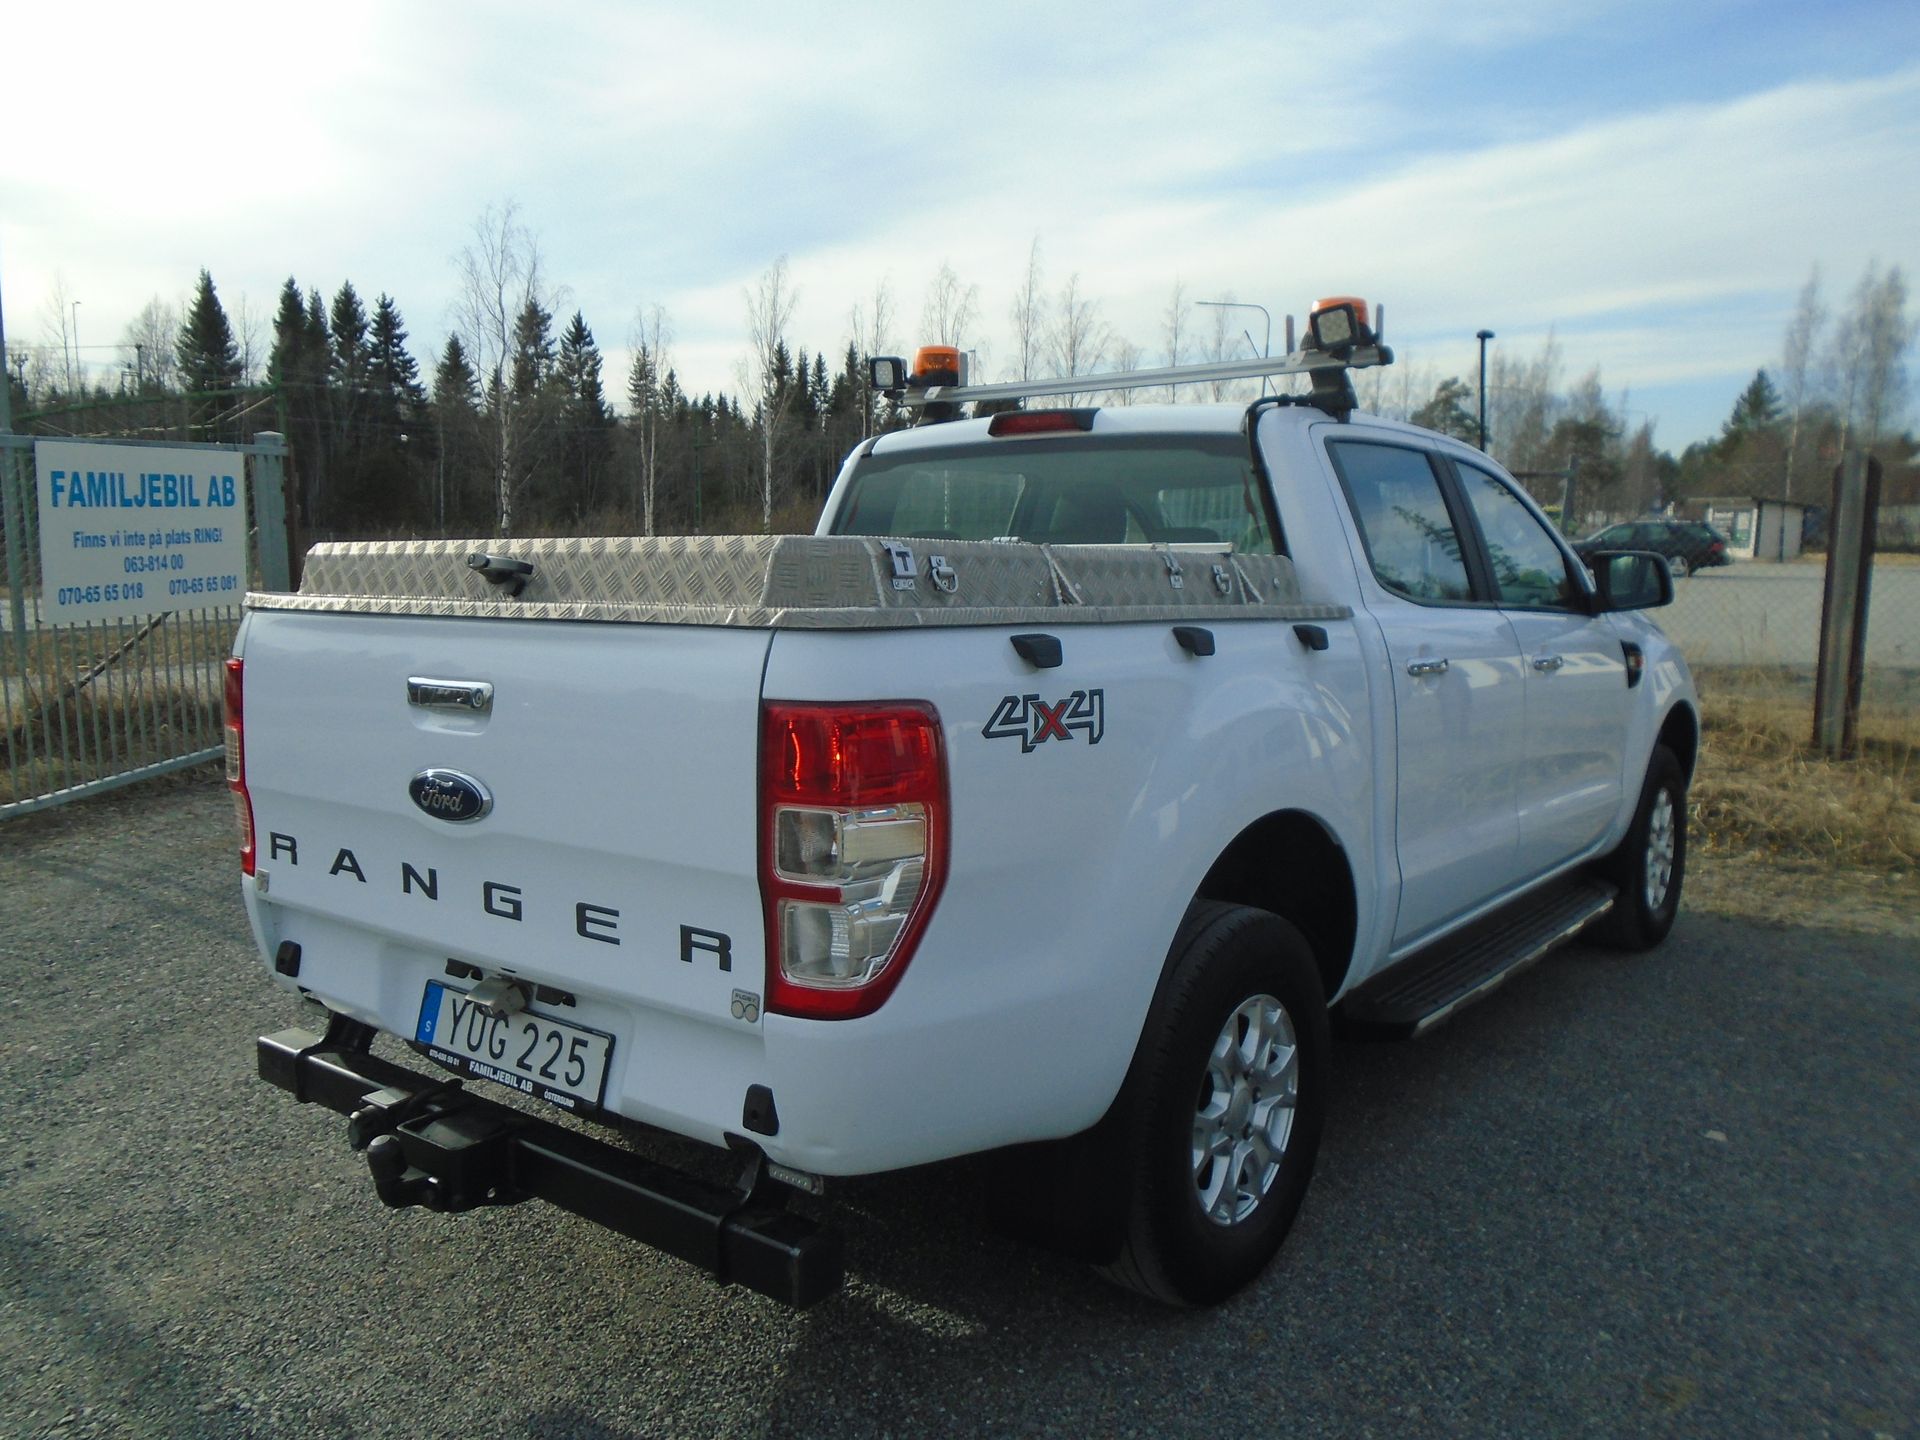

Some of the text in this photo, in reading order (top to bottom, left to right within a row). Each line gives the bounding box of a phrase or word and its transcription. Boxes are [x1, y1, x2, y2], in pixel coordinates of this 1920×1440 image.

[51, 470, 236, 508] FAMILJEBIL AB
[73, 527, 223, 549] Finns vi inte på plats RING!
[124, 554, 184, 573] 063-814 00
[58, 583, 143, 605] 070-65 65 018
[169, 577, 203, 596] 070-65
[206, 576, 218, 592] 65
[421, 777, 464, 812] Ford
[269, 831, 732, 972] RANGER
[424, 1020, 431, 1033] S
[516, 1022, 589, 1087] 225
[469, 1060, 534, 1093] FAMILJEBIL AB
